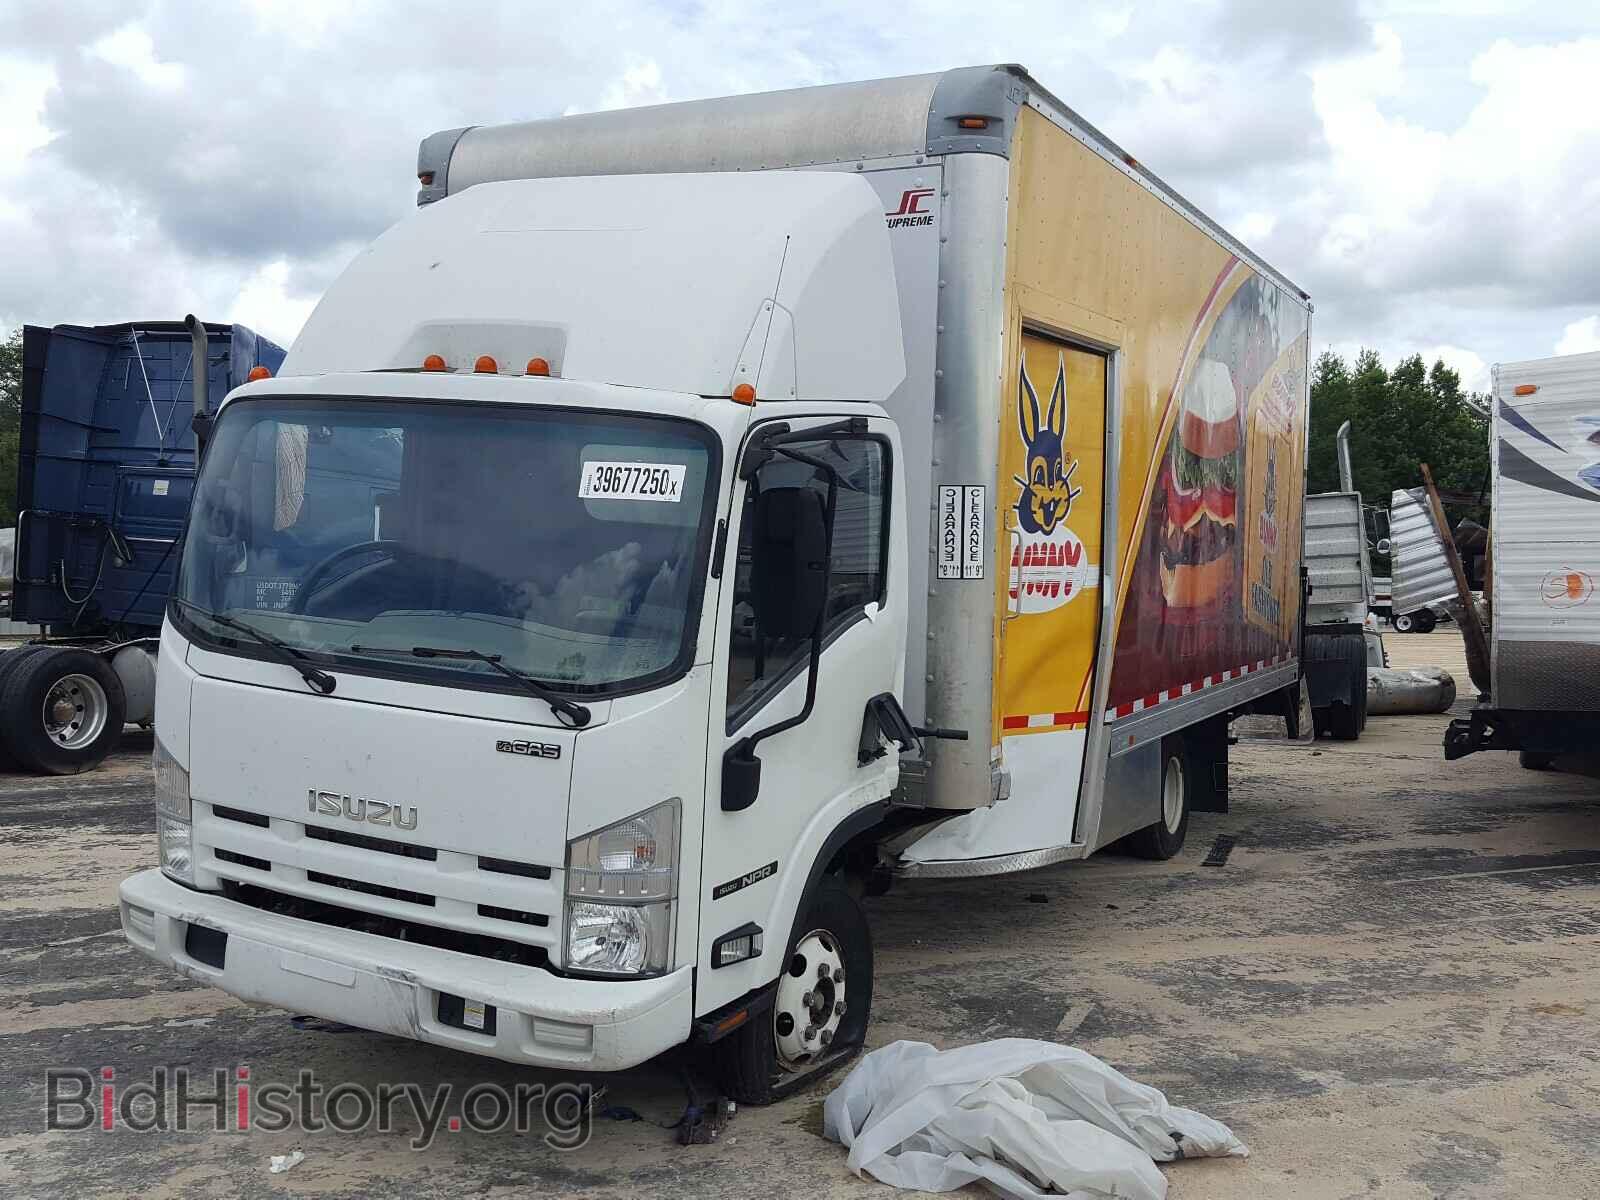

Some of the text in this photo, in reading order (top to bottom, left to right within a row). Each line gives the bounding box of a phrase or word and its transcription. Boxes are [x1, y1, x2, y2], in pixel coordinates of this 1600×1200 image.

[886, 216, 934, 229] UPREME
[970, 489, 981, 562] CLEARANCE
[308, 788, 418, 831] ISUZU
[742, 866, 772, 888] NPR
